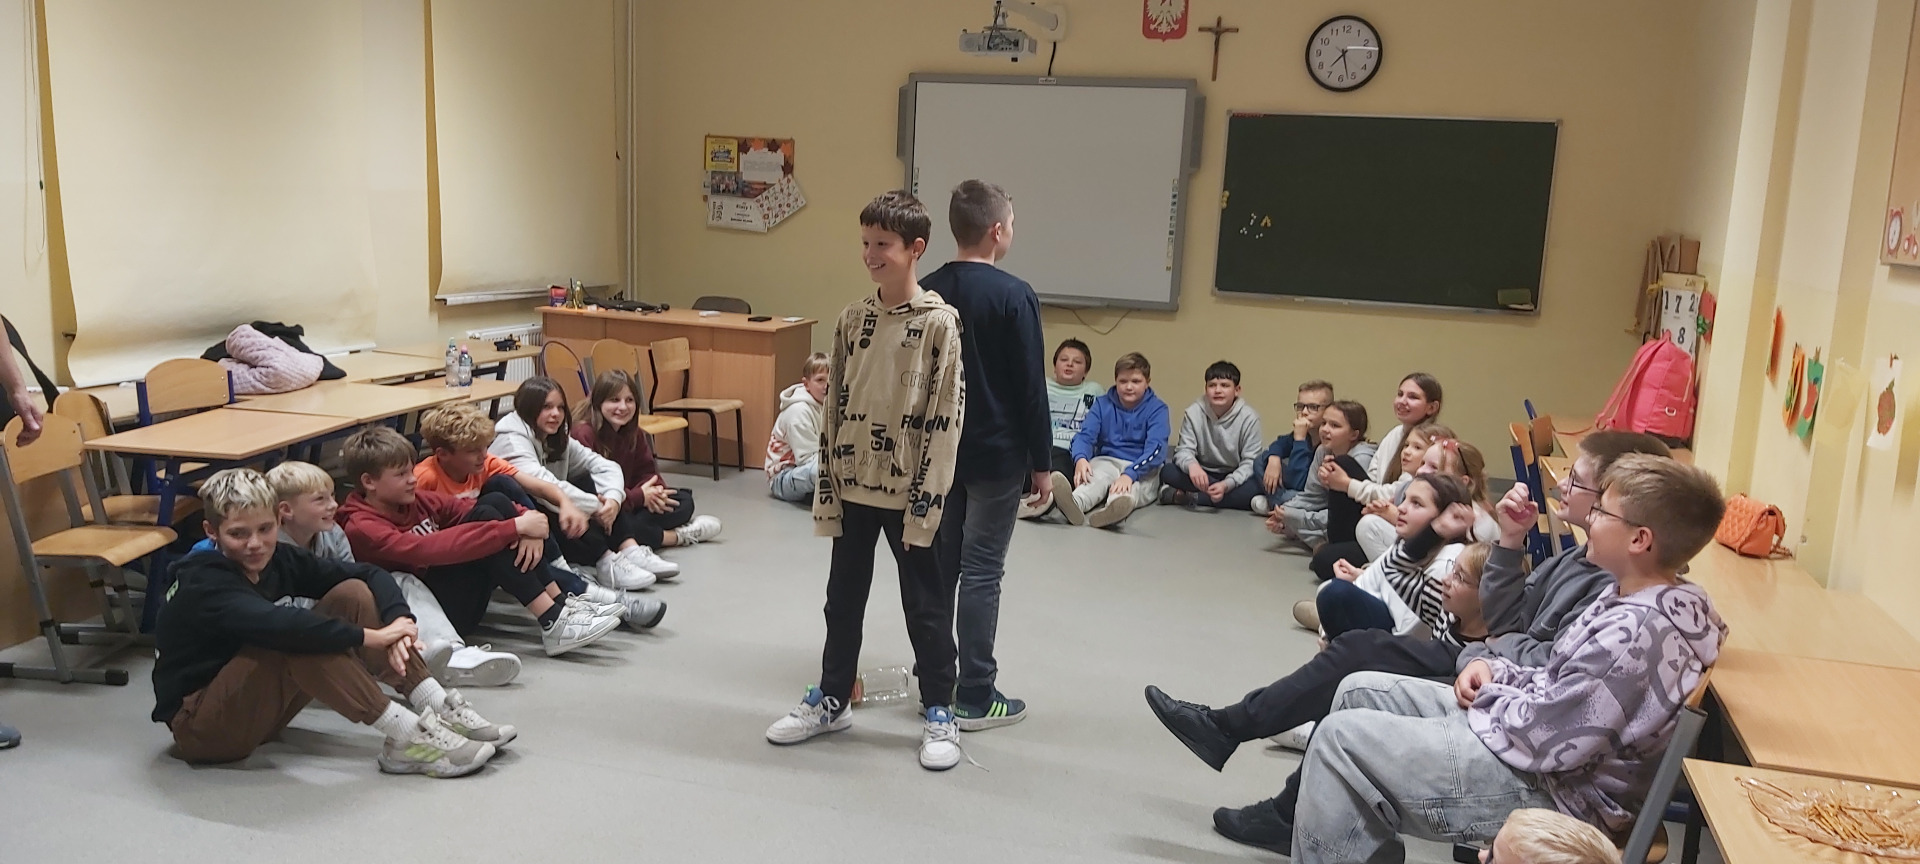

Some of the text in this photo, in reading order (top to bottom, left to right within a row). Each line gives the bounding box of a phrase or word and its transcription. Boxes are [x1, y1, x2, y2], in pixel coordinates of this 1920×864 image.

[1330, 28, 1339, 36] 11
[1342, 25, 1352, 33] 12
[1357, 29, 1361, 37] 1
[1320, 37, 1330, 46] 10
[1363, 38, 1369, 46] 2
[1315, 49, 1322, 57] 9
[1366, 51, 1373, 59] 3
[1318, 61, 1324, 70] 8
[1361, 63, 1367, 71] 4
[1327, 71, 1333, 79] 7
[1337, 75, 1344, 83] 6
[1350, 72, 1357, 80] 5
[1675, 295, 1682, 314] 7
[1677, 327, 1686, 344] 8
